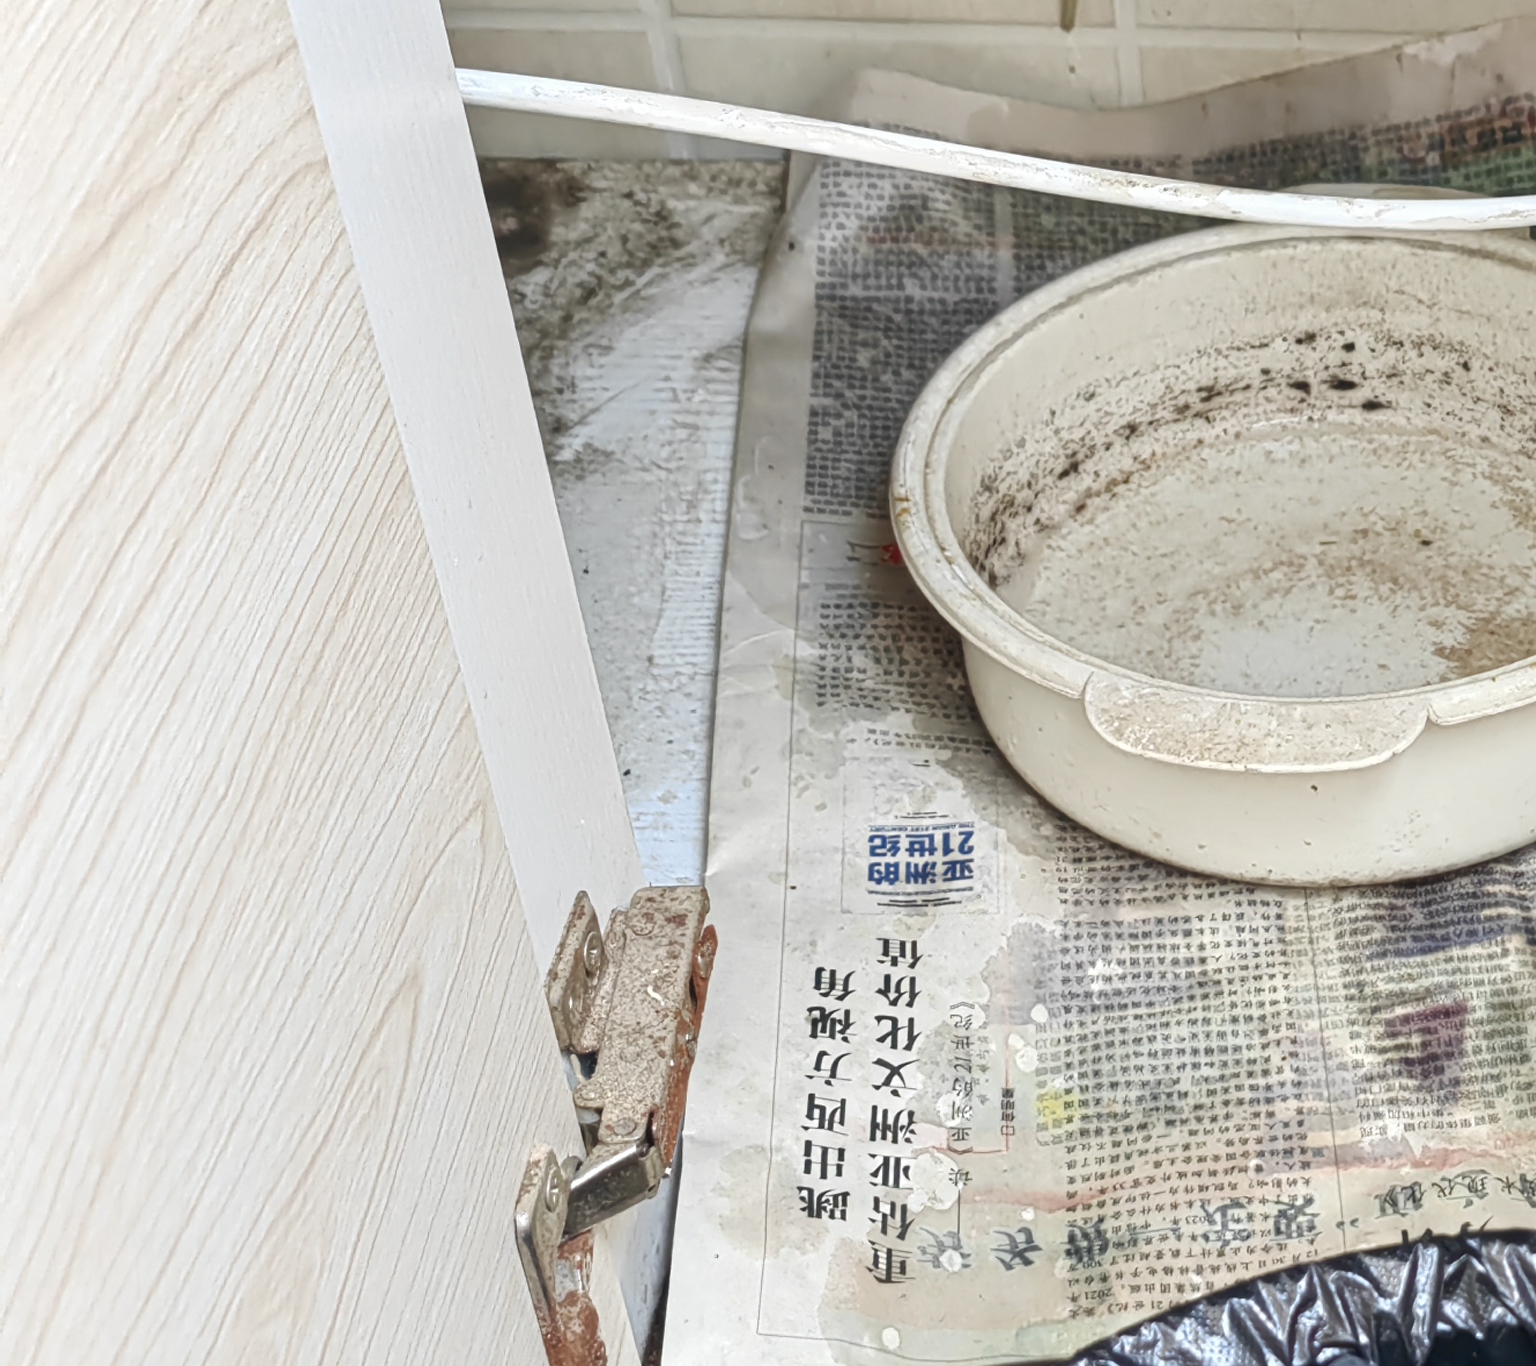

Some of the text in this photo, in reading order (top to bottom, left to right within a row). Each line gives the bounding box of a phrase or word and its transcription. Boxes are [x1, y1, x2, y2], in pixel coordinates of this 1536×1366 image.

[868, 830, 975, 858] 21世纪
[868, 859, 975, 887] 亚洲的
[797, 965, 857, 1222] 跳出西方视角
[866, 936, 924, 1286] 重估亚洲文化价值
